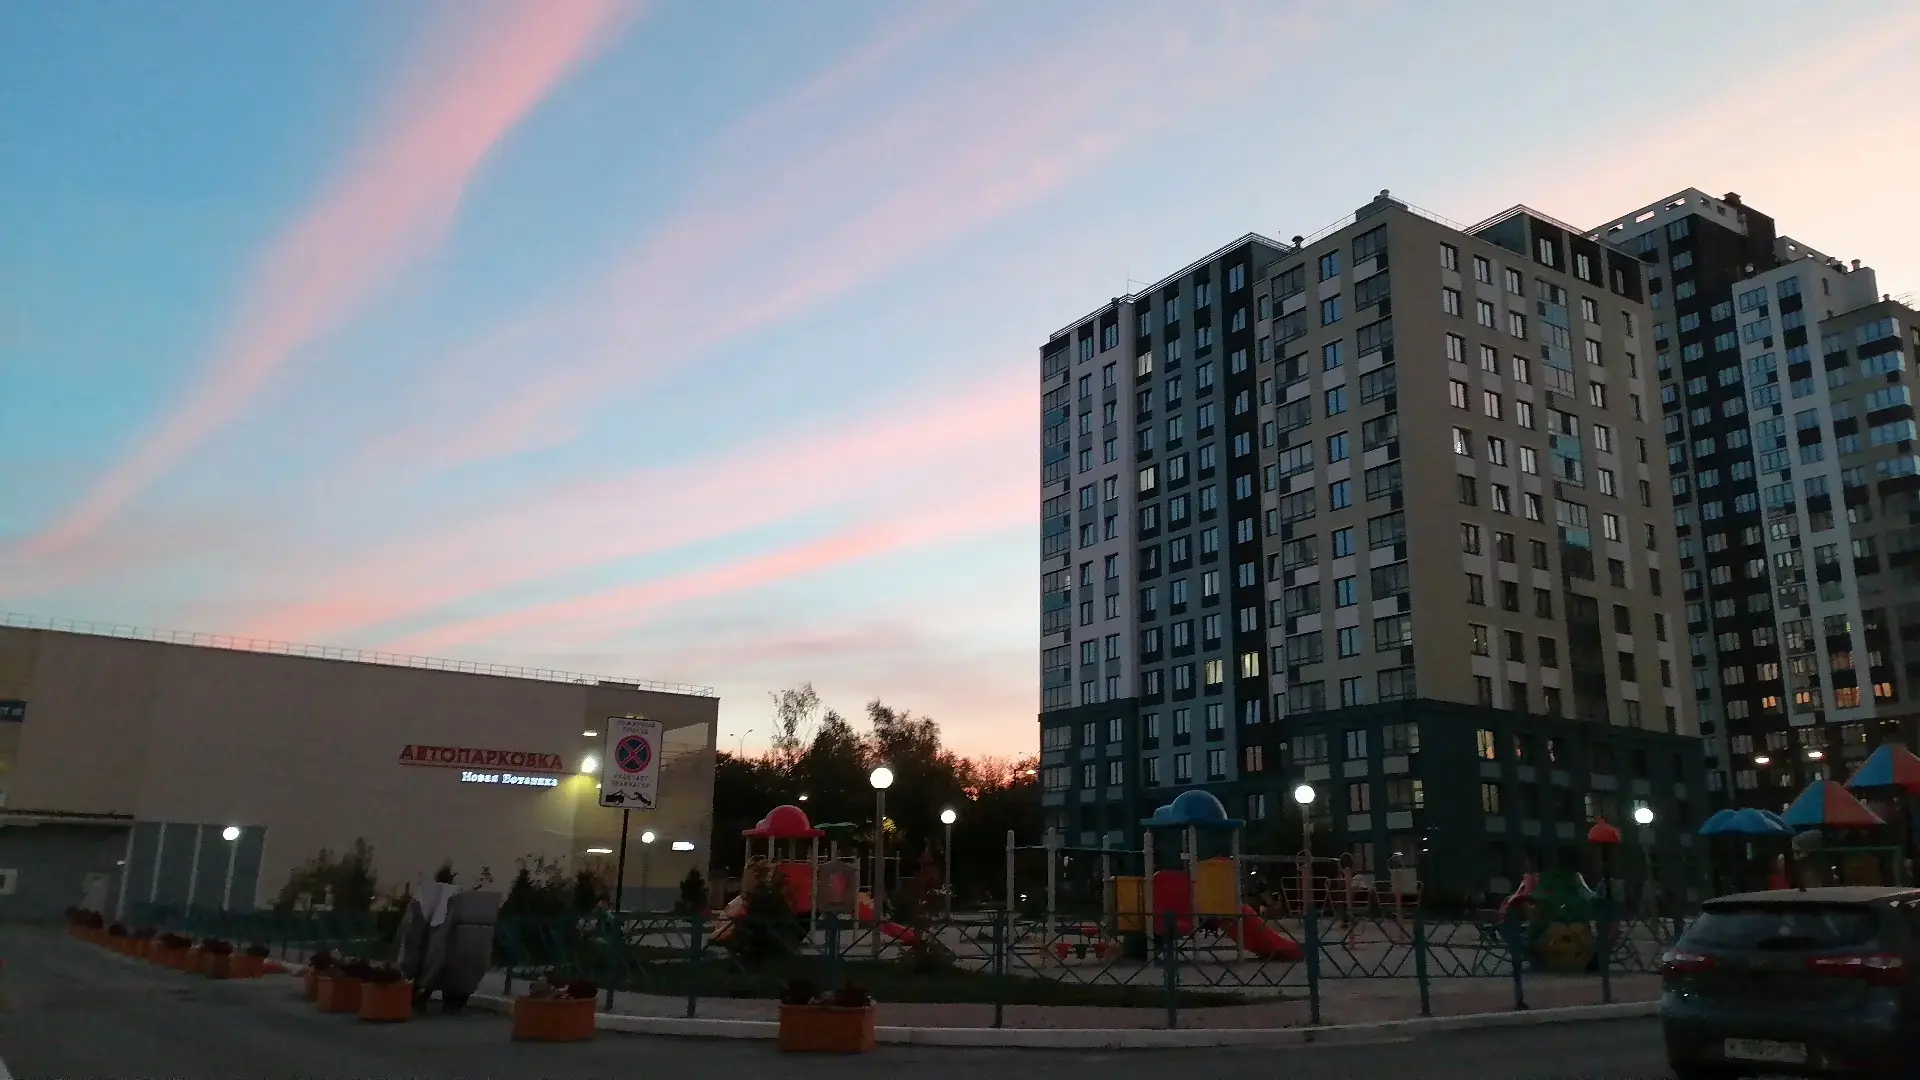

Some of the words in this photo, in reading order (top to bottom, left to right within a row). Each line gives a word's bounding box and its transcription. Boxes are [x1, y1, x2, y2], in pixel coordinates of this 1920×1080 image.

[399, 744, 563, 770] АВТОПАРКОВКА
[461, 771, 500, 784] Новая
[501, 773, 559, 788] Ботаника
